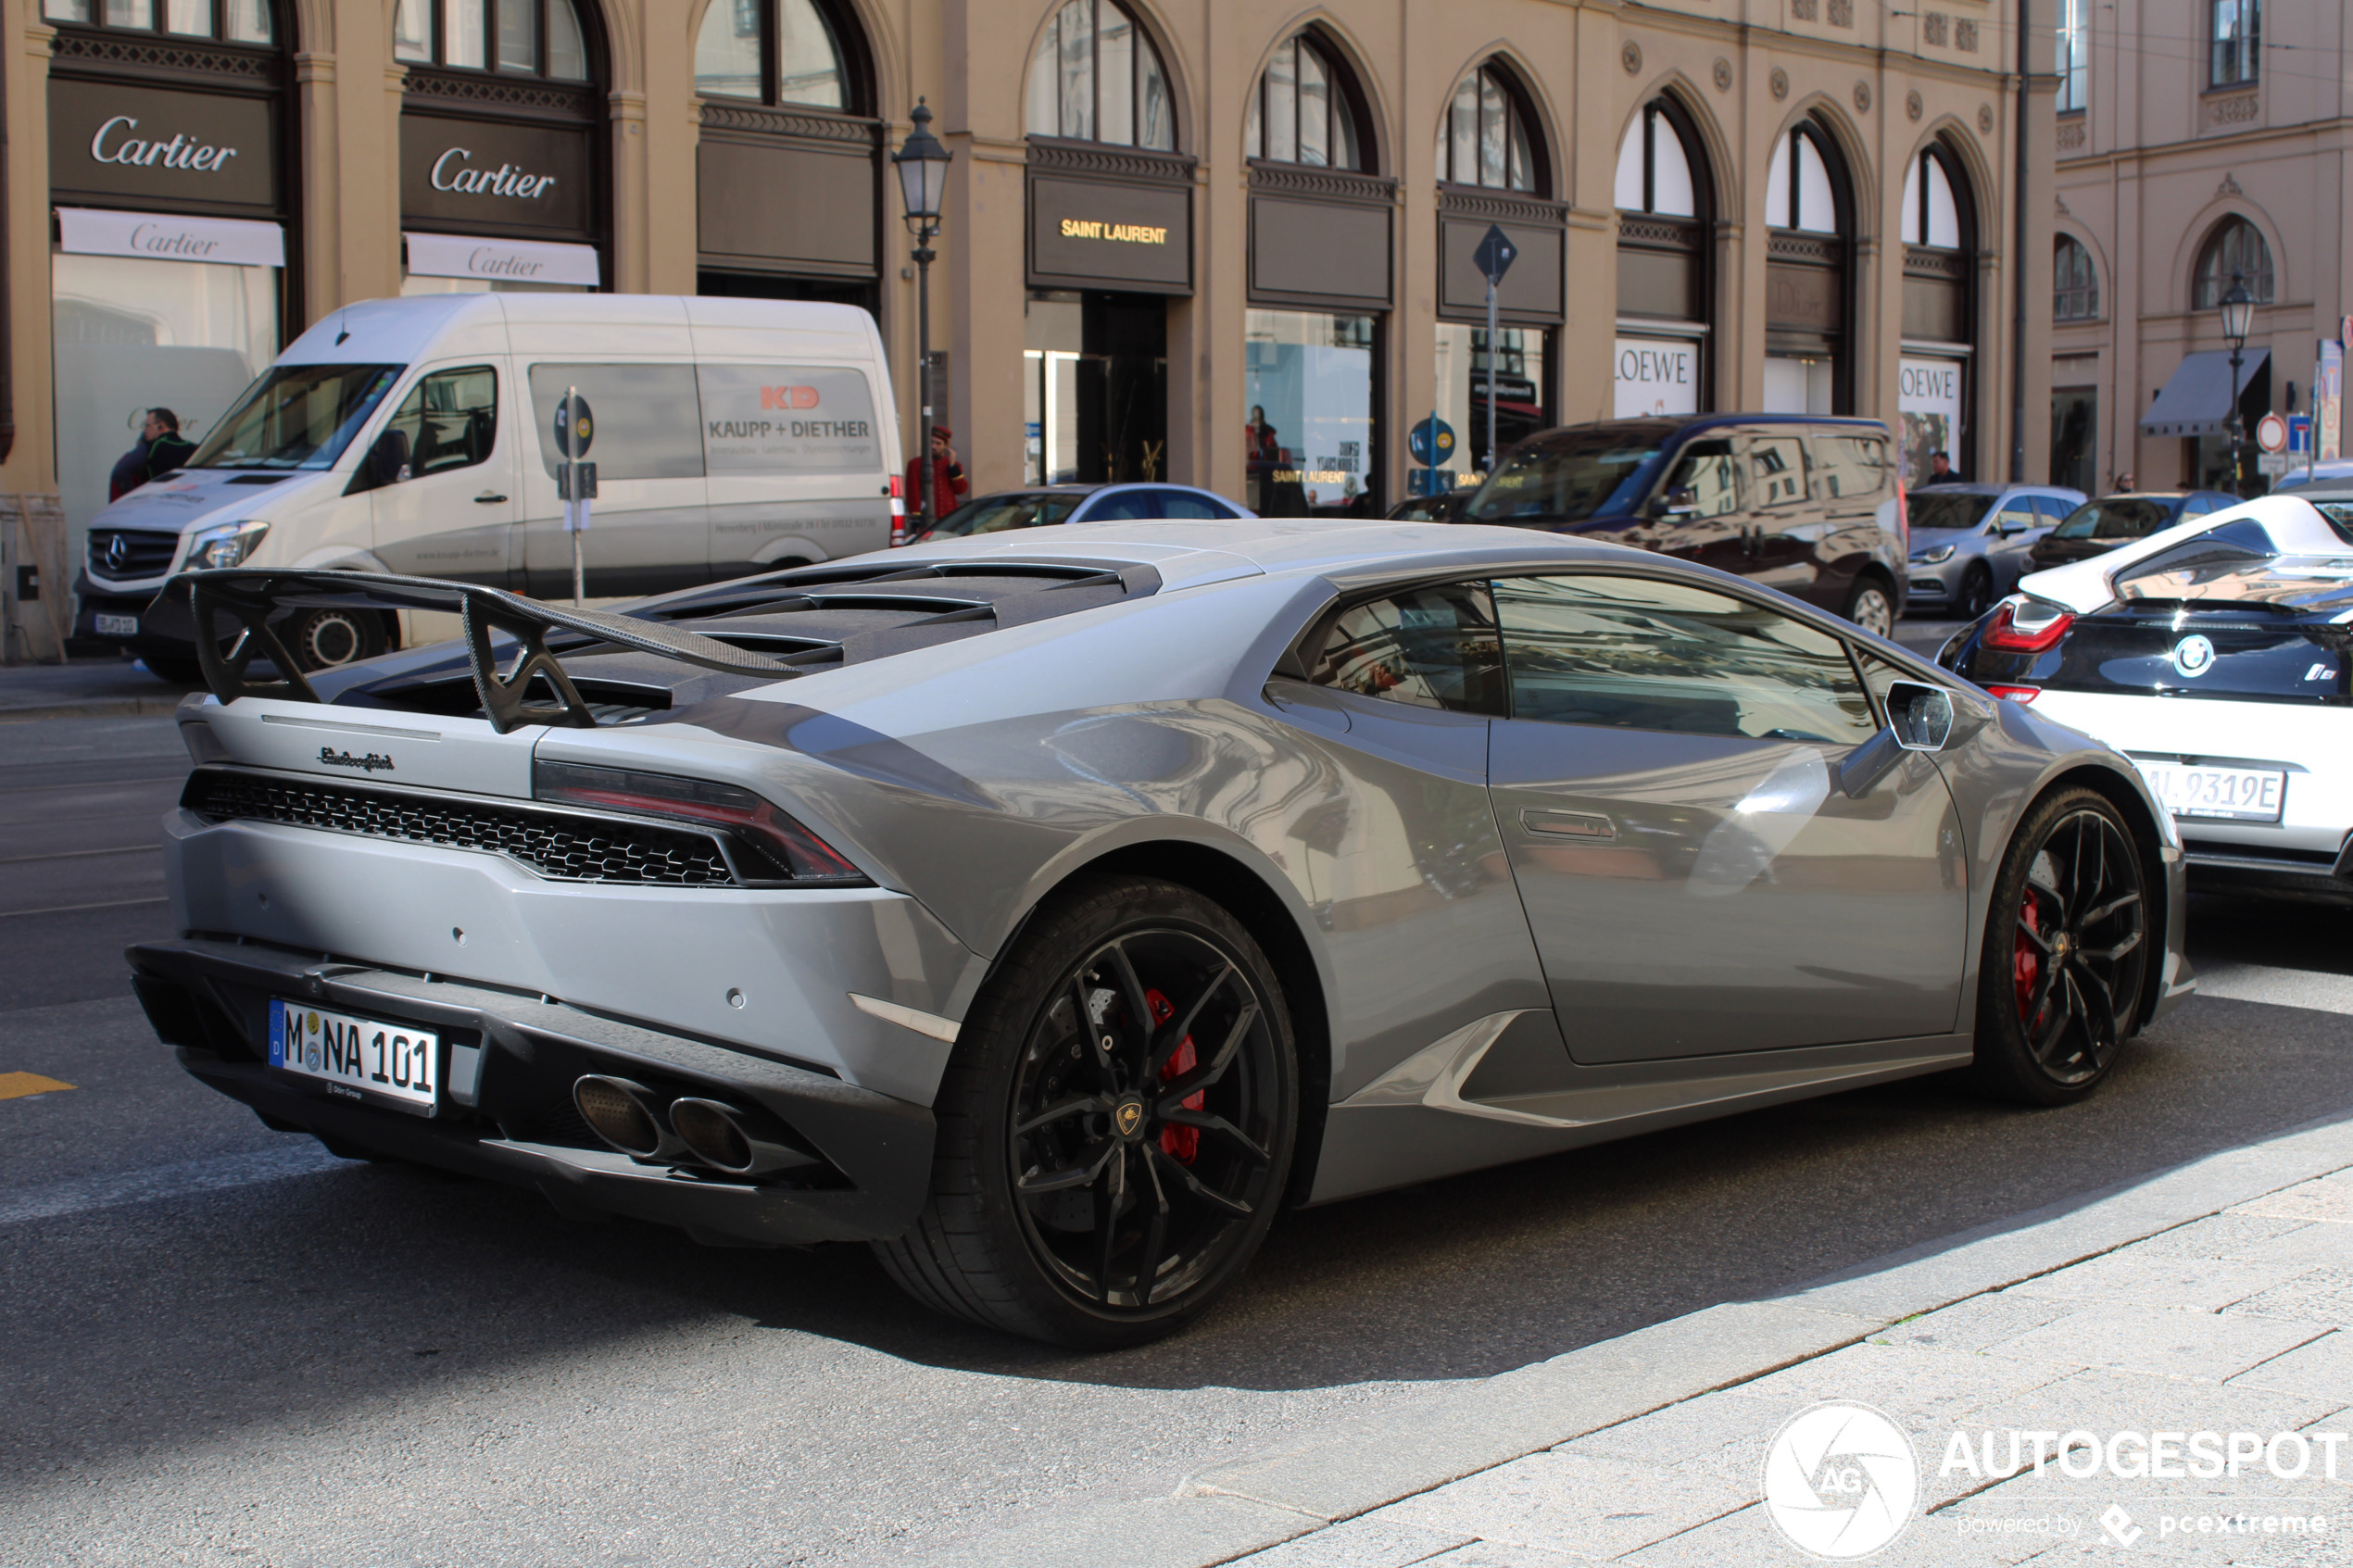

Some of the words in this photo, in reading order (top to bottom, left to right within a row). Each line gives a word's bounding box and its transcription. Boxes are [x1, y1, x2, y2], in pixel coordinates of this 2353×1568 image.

[91, 116, 237, 171] Cartier
[431, 146, 556, 198] Cartier
[130, 222, 219, 256] Cartier
[1061, 219, 1102, 239] SAINT
[1103, 223, 1167, 245] LAURENT
[468, 245, 543, 276] Cartier
[1777, 280, 1821, 317] Dior
[760, 385, 820, 409] KD
[1899, 368, 1954, 399] OEWE
[709, 420, 771, 438] KAUPP
[775, 423, 786, 436] +
[790, 420, 869, 438] DIETHER
[1272, 470, 1302, 483] SAINT
[1302, 470, 1346, 483] LAURENT
[2186, 772, 2278, 809] 9319E
[273, 1040, 280, 1056] D
[285, 1010, 303, 1064] M
[324, 1019, 363, 1079] NA
[371, 1031, 433, 1094] 101
[346, 1088, 362, 1100] Group
